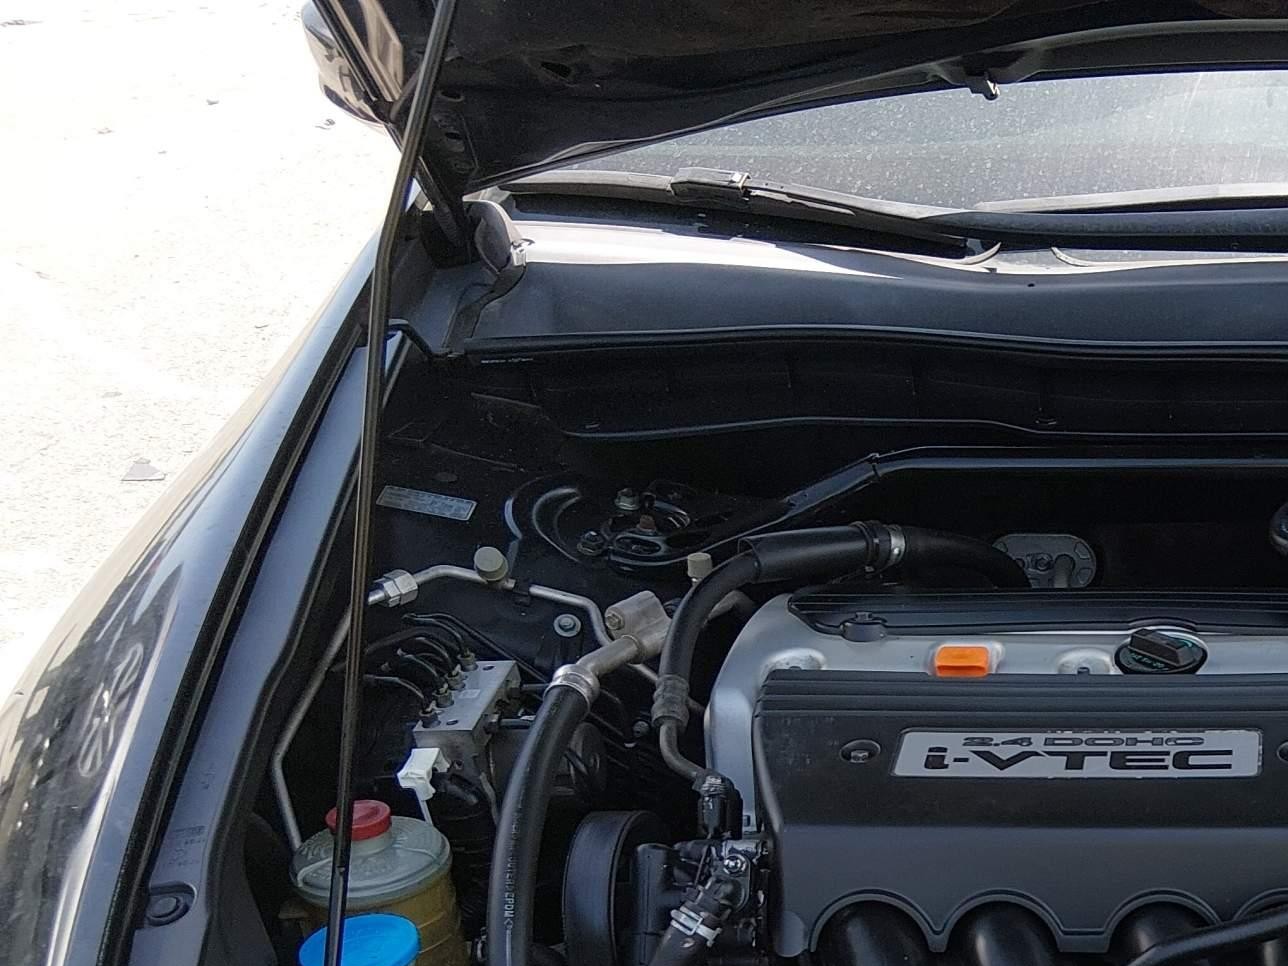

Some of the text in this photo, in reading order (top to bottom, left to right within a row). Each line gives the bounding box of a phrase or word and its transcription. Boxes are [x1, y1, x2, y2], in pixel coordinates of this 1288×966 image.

[962, 736, 1206, 748] 2.4 DOHC
[923, 746, 1234, 772] i-VTEC
